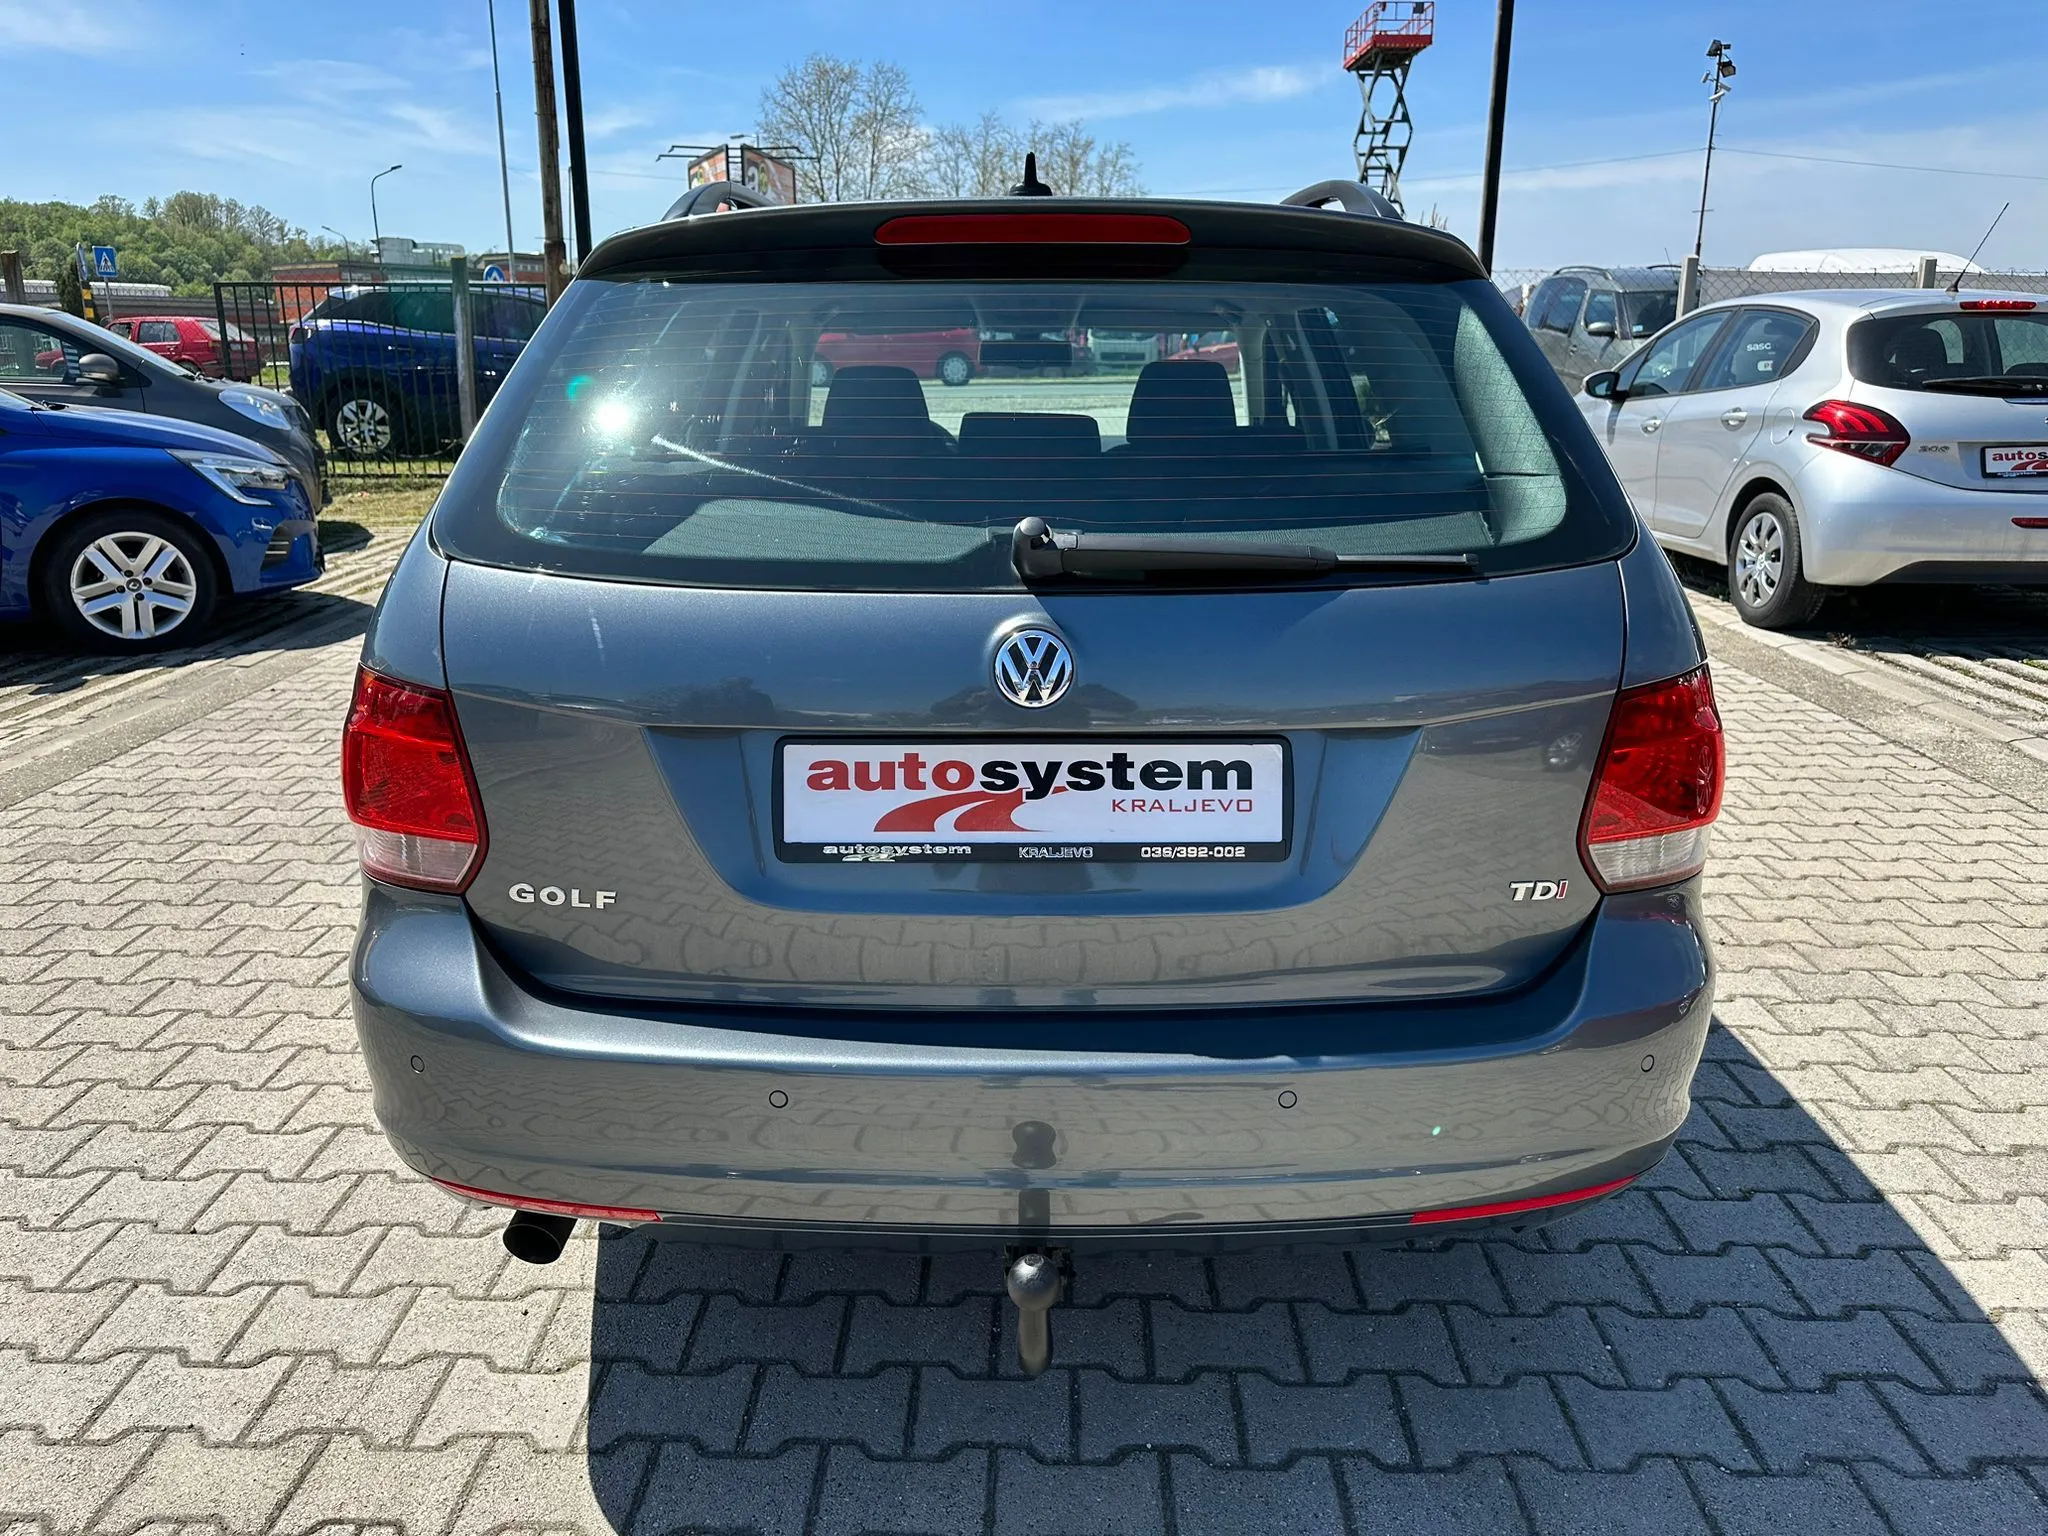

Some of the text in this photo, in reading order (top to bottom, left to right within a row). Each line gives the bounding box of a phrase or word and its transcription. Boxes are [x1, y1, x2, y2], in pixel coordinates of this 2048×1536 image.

[997, 630, 1072, 708] VW
[806, 752, 1253, 800] autosystem
[1112, 799, 1253, 813] KRALJEVO
[822, 843, 1246, 859] autosystem KRALJEVO 036/392-002
[508, 882, 617, 909] GOLF
[1509, 879, 1569, 902] TDI
